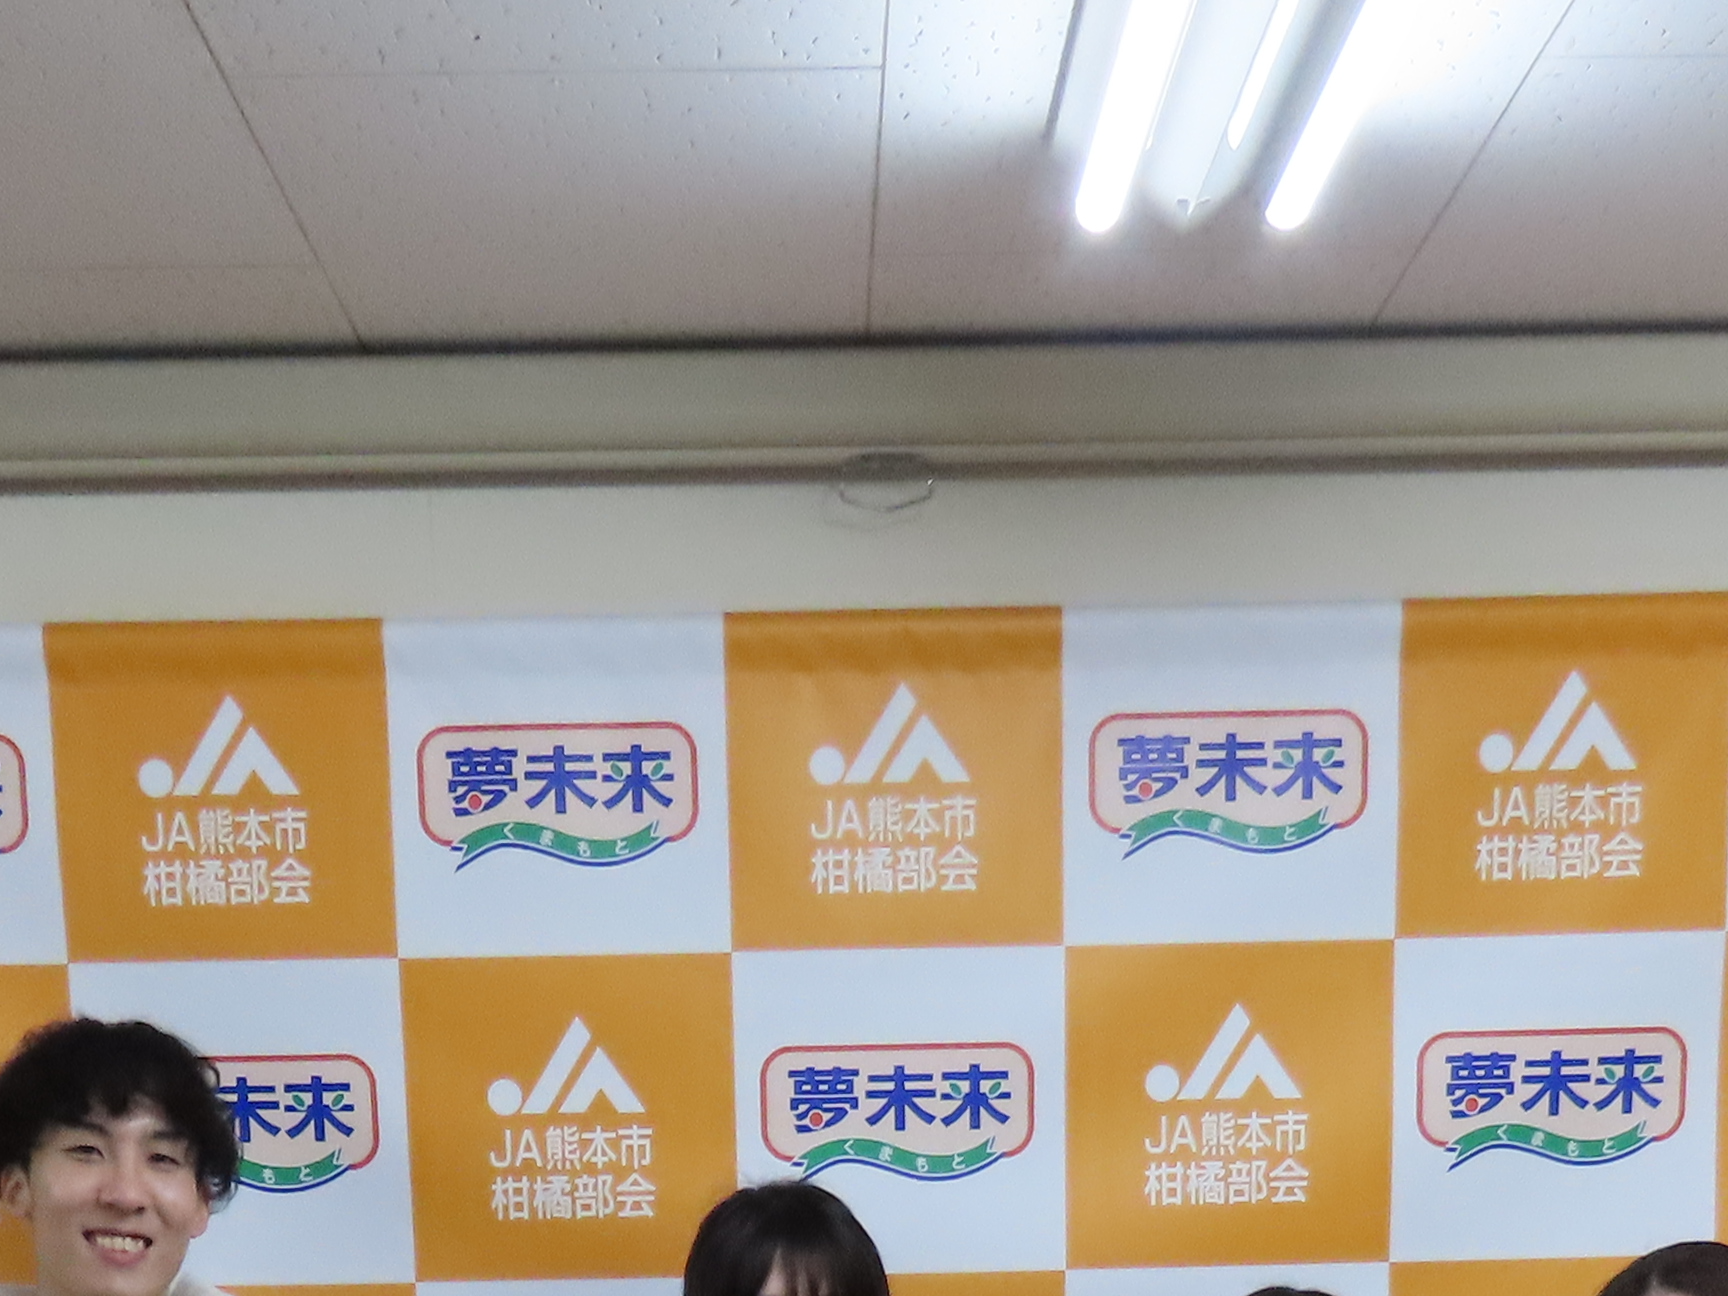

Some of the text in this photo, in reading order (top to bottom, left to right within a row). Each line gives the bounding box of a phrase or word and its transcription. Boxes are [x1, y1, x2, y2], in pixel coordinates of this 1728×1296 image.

[446, 744, 674, 816] 夢未来
[1119, 732, 1345, 803] 夢未来
[142, 807, 308, 854] JA熊本市
[810, 795, 978, 843] JA熊本市
[1173, 809, 1298, 844] くまもと
[1477, 782, 1645, 831] JA熊本市
[503, 822, 630, 857] くまもと
[1475, 831, 1645, 881] 柑橘部会
[143, 856, 311, 906] 柑橘部会
[810, 843, 980, 894] 柑橘部会
[788, 1064, 1012, 1134] 夢未来
[1446, 1049, 1664, 1118] 夢未来
[215, 1075, 354, 1143] 未来
[1144, 1109, 1310, 1156] JA熊本市
[490, 1124, 653, 1171] JA熊本市
[844, 1140, 966, 1173] くまもと
[1497, 1123, 1616, 1156] くまもと
[491, 1172, 656, 1220] 柑橘部会
[1143, 1157, 1310, 1206] 柑橘部会
